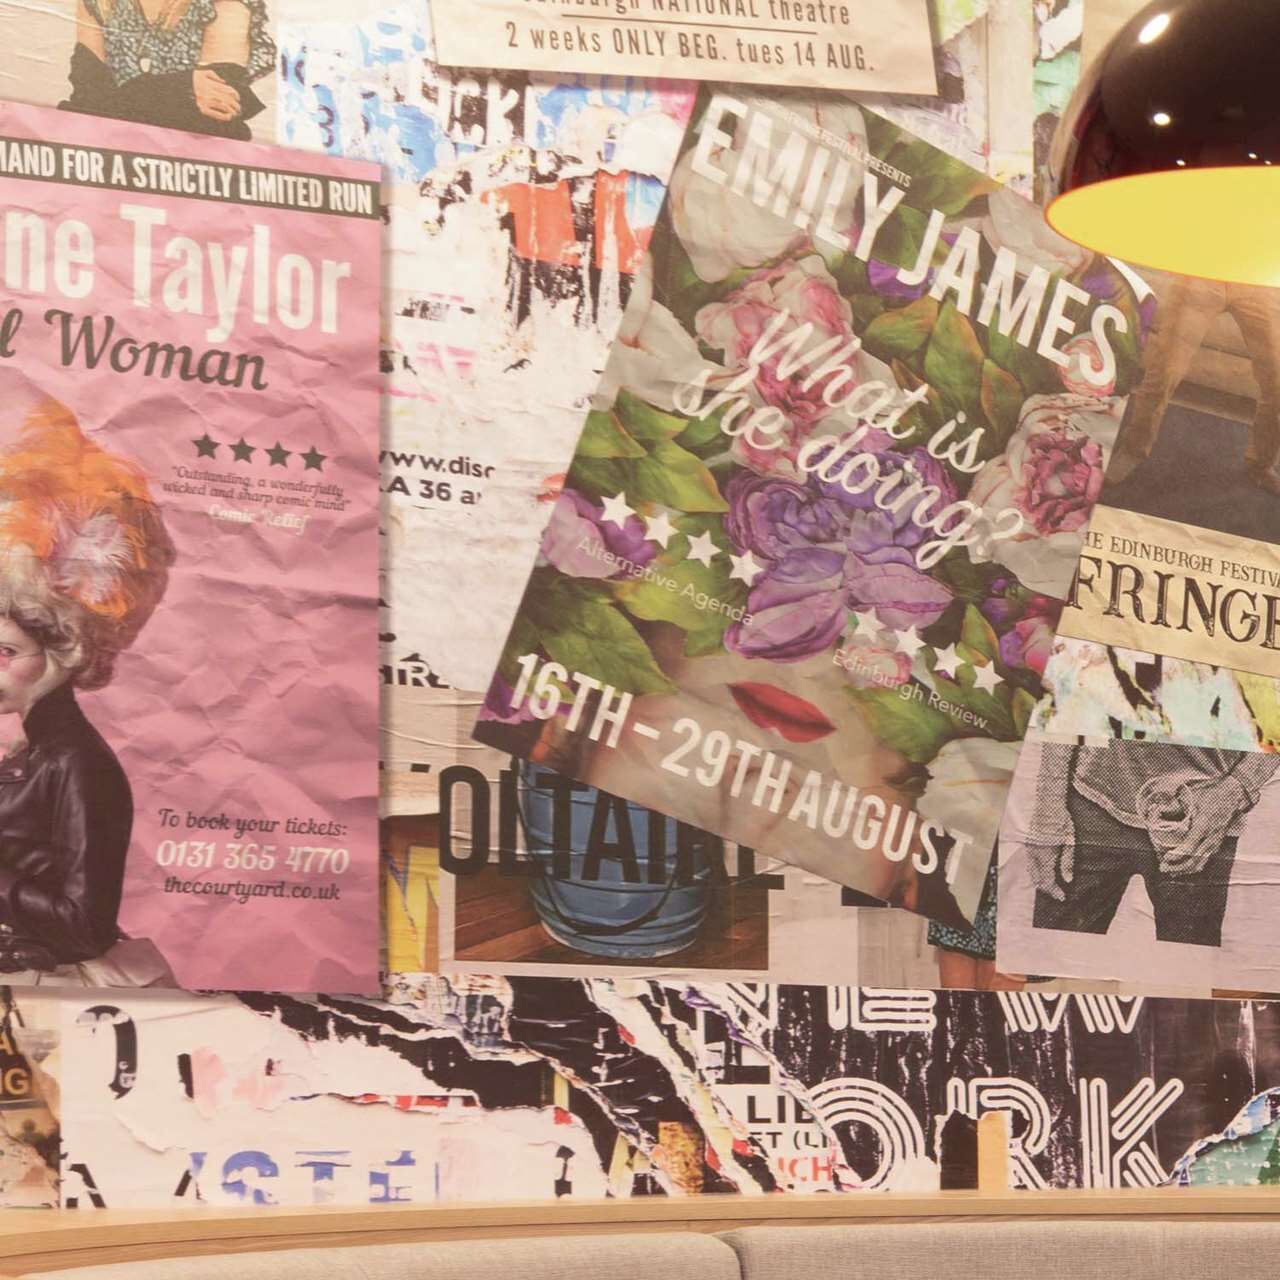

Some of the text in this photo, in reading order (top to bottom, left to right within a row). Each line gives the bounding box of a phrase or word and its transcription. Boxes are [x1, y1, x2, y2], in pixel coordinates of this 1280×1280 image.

[506, 22, 875, 71] 2 weeks ONLY BEG. tues 14 AUG.
[62, 148, 105, 184] FOR
[111, 155, 128, 187] A
[132, 157, 234, 198] STRICTLY
[239, 169, 324, 209] LIMITED
[329, 180, 373, 214] RUN
[691, 93, 906, 262] EMILY
[896, 209, 1128, 385] JAMES
[119, 204, 352, 343] Taylor
[45, 309, 269, 390] Woman
[750, 308, 987, 473] What is
[270, 478, 344, 497] wonderfully
[419, 478, 452, 502] 36
[672, 364, 1024, 571] she doing?
[210, 487, 234, 499] and
[238, 489, 273, 507] sharp
[276, 496, 311, 508] comic
[1111, 536, 1213, 573] EDINBURGH
[680, 582, 754, 626] Agenda
[833, 648, 989, 731] Edinburgh Review
[508, 652, 634, 748] 16TH
[661, 717, 792, 815] 29TH
[788, 783, 974, 885] AUGUST
[159, 808, 348, 839] To book your tickets:
[155, 840, 350, 875] 0131 365 4770
[164, 876, 341, 904] thecourtyard.co.uk
